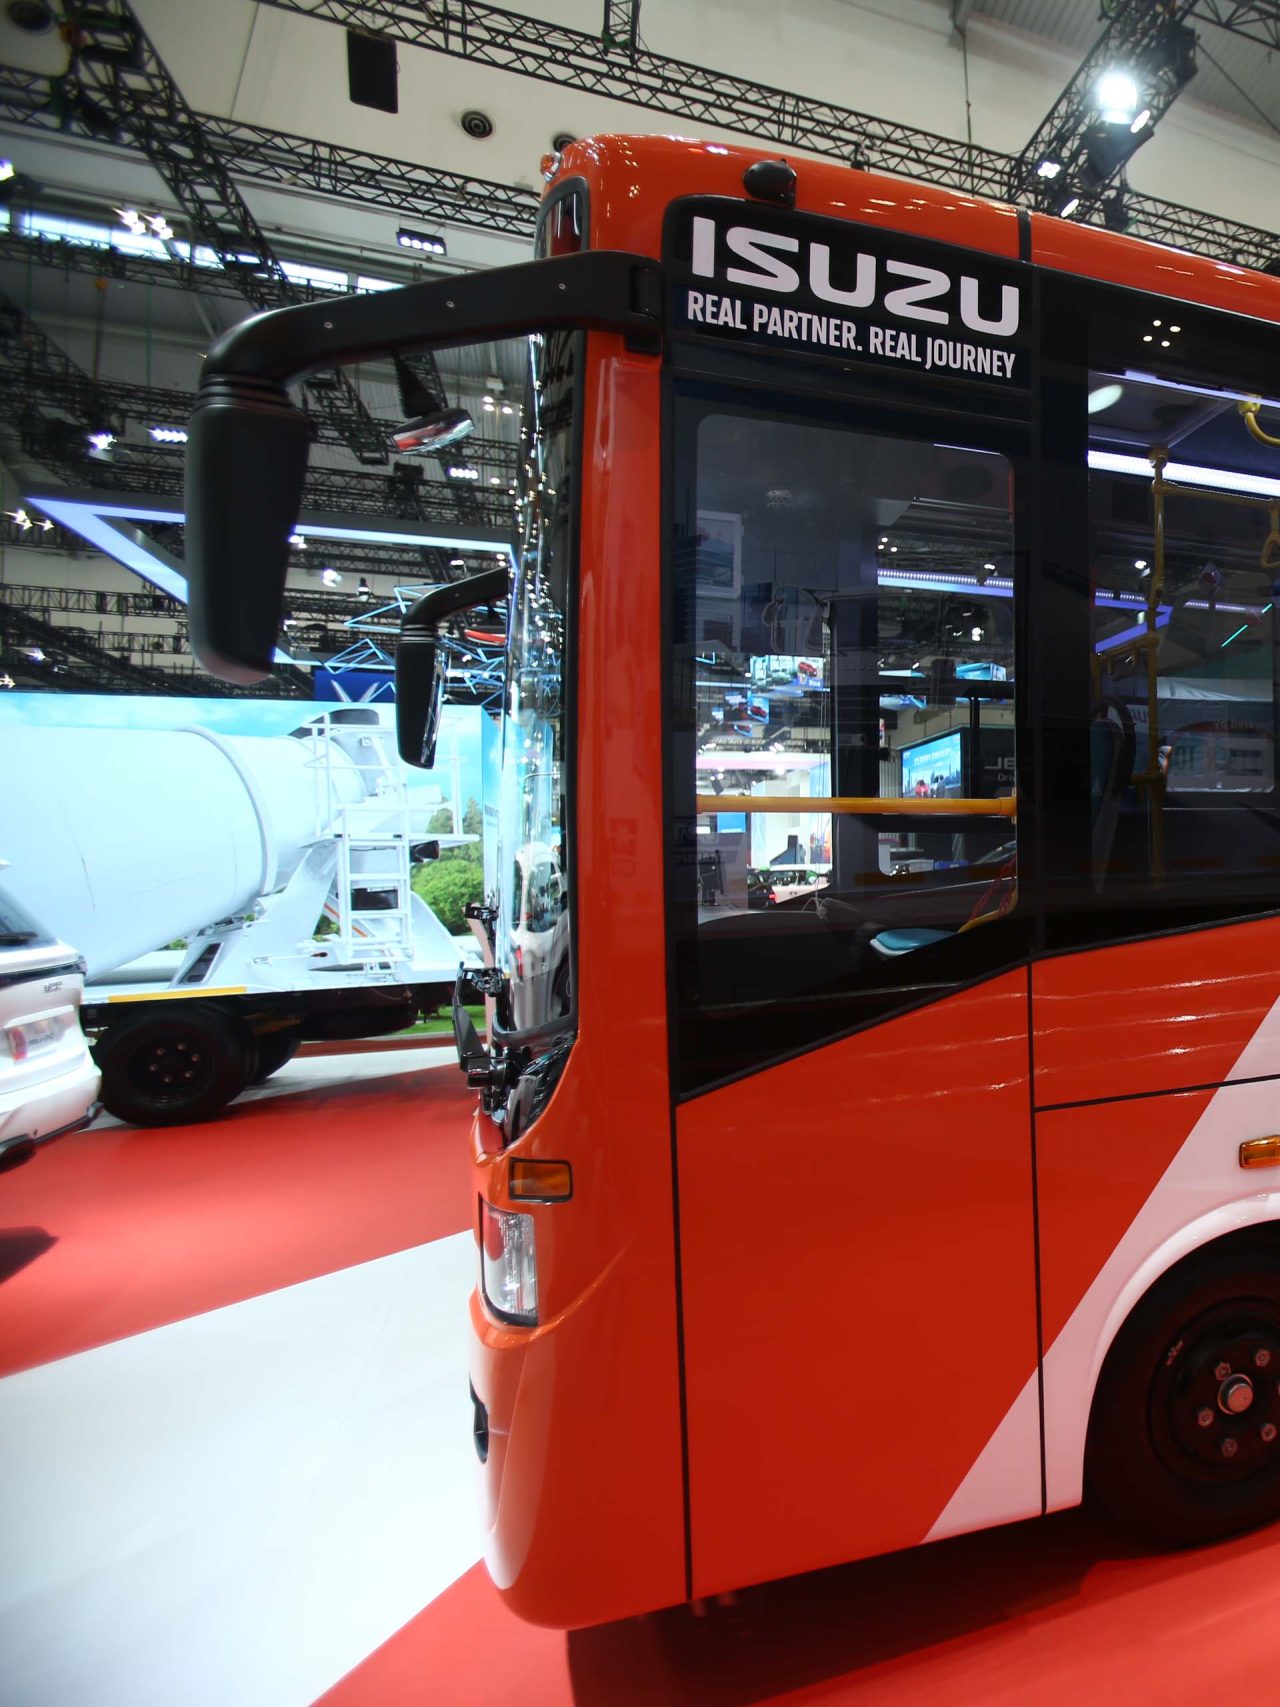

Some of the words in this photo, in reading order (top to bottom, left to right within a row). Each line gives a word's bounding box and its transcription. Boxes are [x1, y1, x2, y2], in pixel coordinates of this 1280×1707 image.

[692, 216, 1019, 336] ISUZU
[687, 290, 747, 330] REAL
[753, 304, 862, 352] PARTNER.
[869, 326, 921, 362] REAL
[925, 338, 1016, 378] JOURNEY
